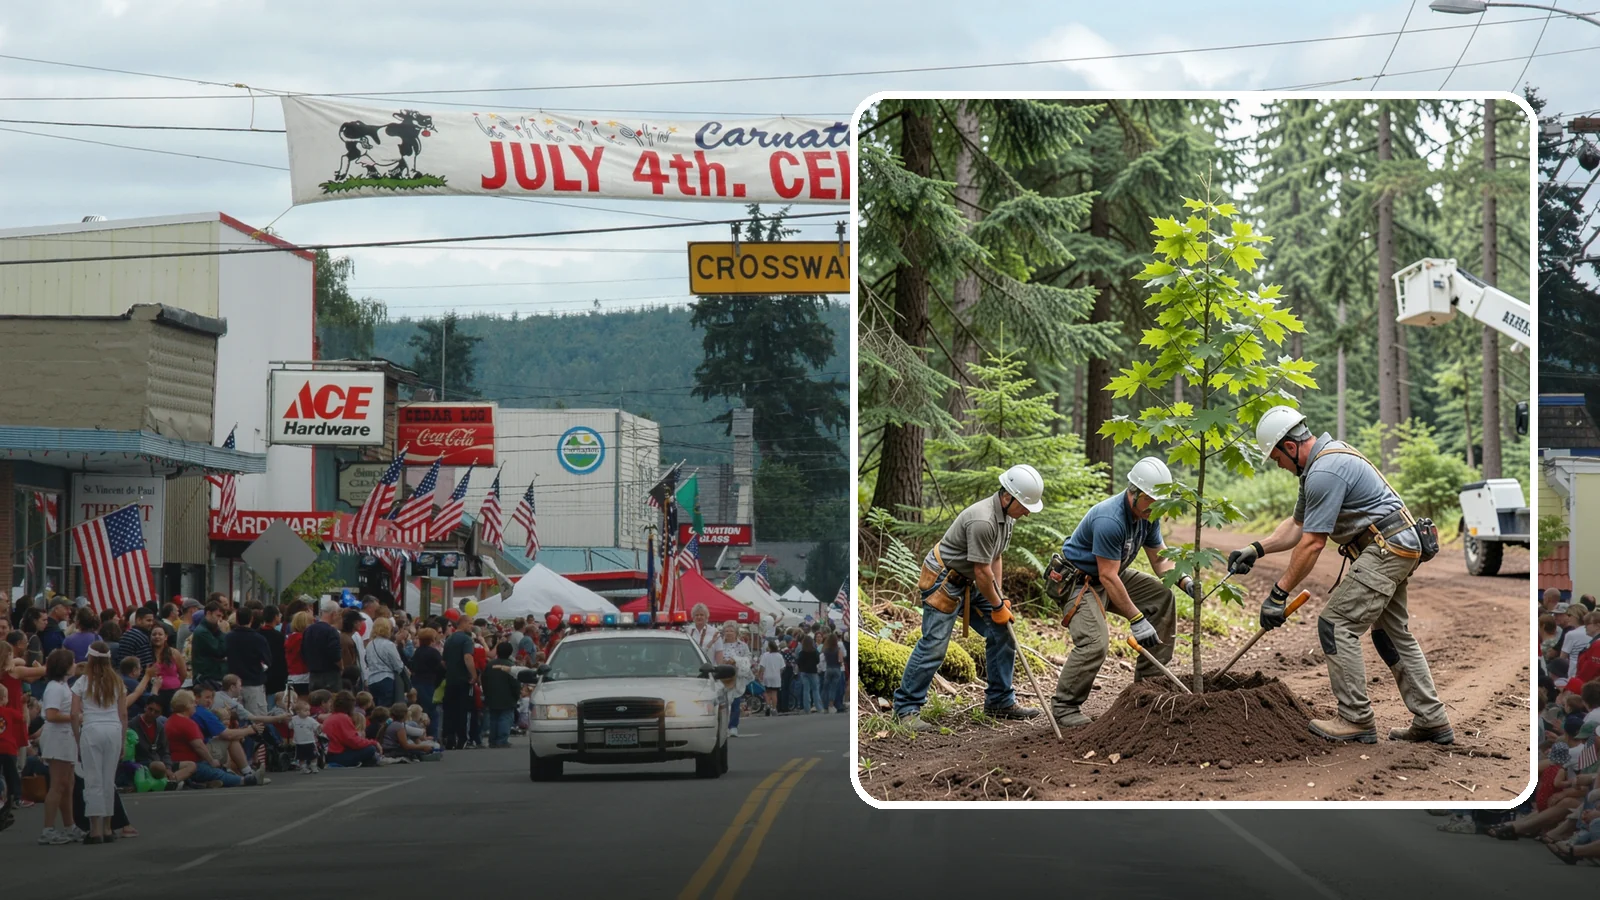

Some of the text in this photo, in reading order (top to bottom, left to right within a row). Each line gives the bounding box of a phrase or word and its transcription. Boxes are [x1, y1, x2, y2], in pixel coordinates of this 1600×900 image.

[481, 140, 605, 192] JULY
[632, 150, 746, 197] 4th.
[697, 254, 850, 280] CROSSWA
[282, 380, 373, 420] ACE
[405, 409, 485, 422] CEDAR LOG
[283, 421, 370, 436] Hardware
[416, 428, 476, 447] Coca-Cola
[353, 467, 385, 479] Simpl
[83, 485, 154, 495] St. Vincent de Paul
[81, 503, 154, 522] THRT
[212, 515, 330, 535] HARDARE
[688, 526, 741, 535] CRNATION
[699, 535, 730, 543] GLASS
